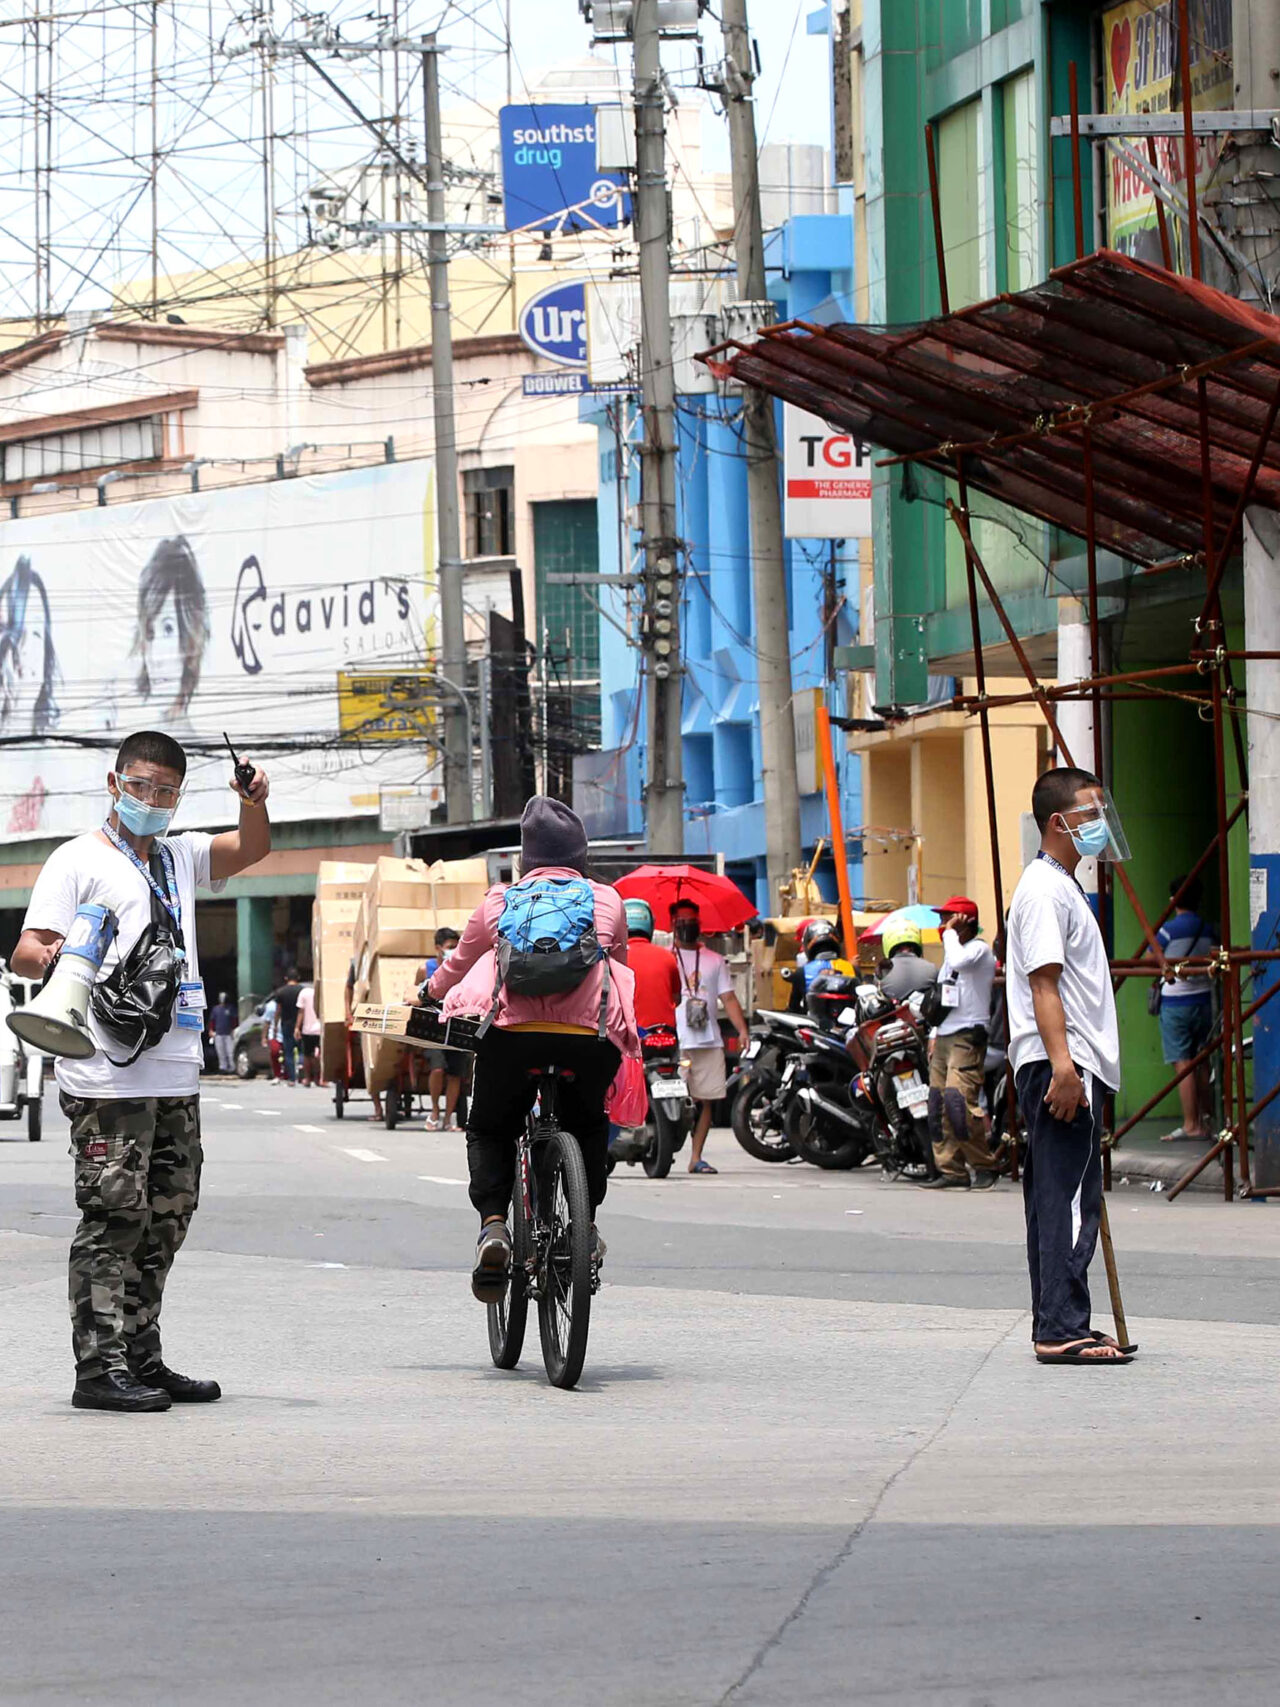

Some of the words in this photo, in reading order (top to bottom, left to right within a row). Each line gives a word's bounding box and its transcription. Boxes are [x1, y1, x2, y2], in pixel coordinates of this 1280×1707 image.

[513, 124, 595, 145] southst
[514, 146, 562, 169] drug
[815, 481, 831, 489] THE
[833, 481, 870, 489] GENERIC
[819, 490, 869, 498] PHARMACY
[270, 581, 410, 636] david's
[343, 632, 409, 656] SALON
